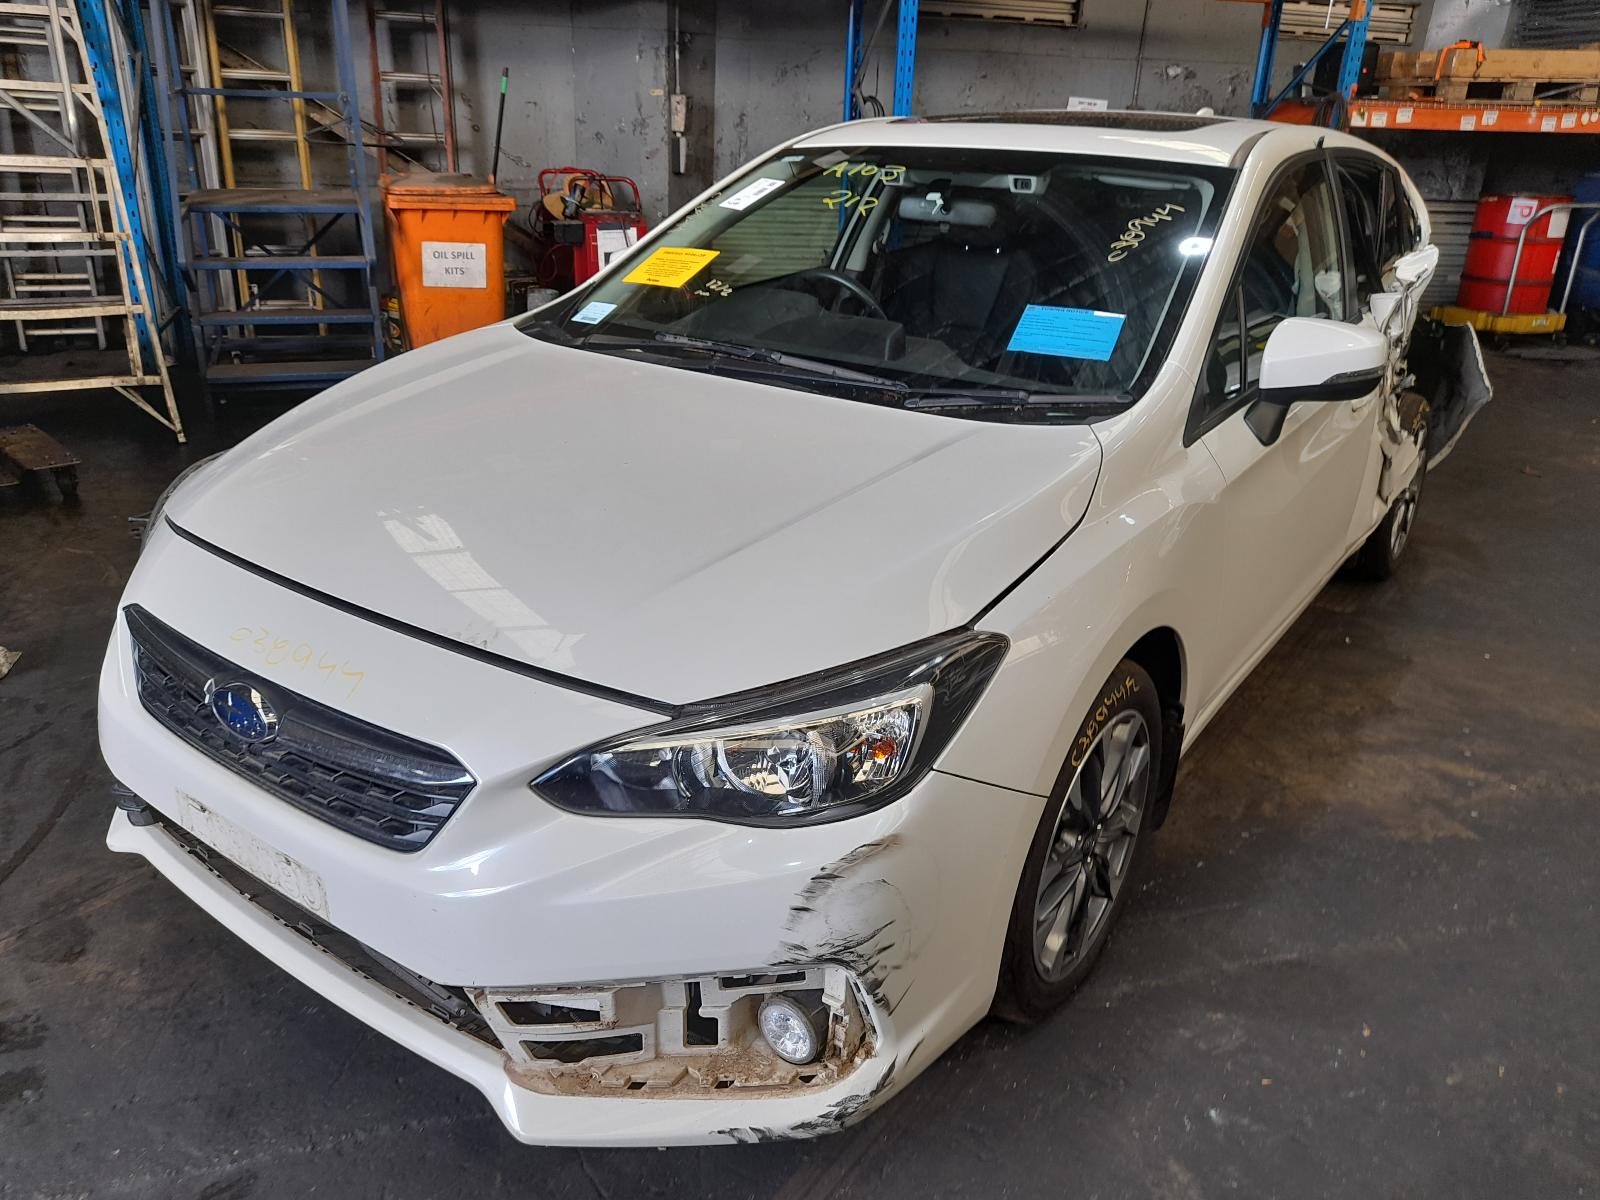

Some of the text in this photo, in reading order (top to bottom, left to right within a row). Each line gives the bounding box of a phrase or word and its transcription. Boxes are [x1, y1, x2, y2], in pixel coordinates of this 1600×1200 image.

[432, 250, 475, 260] OIL SPILL
[444, 266, 465, 275] KITS
